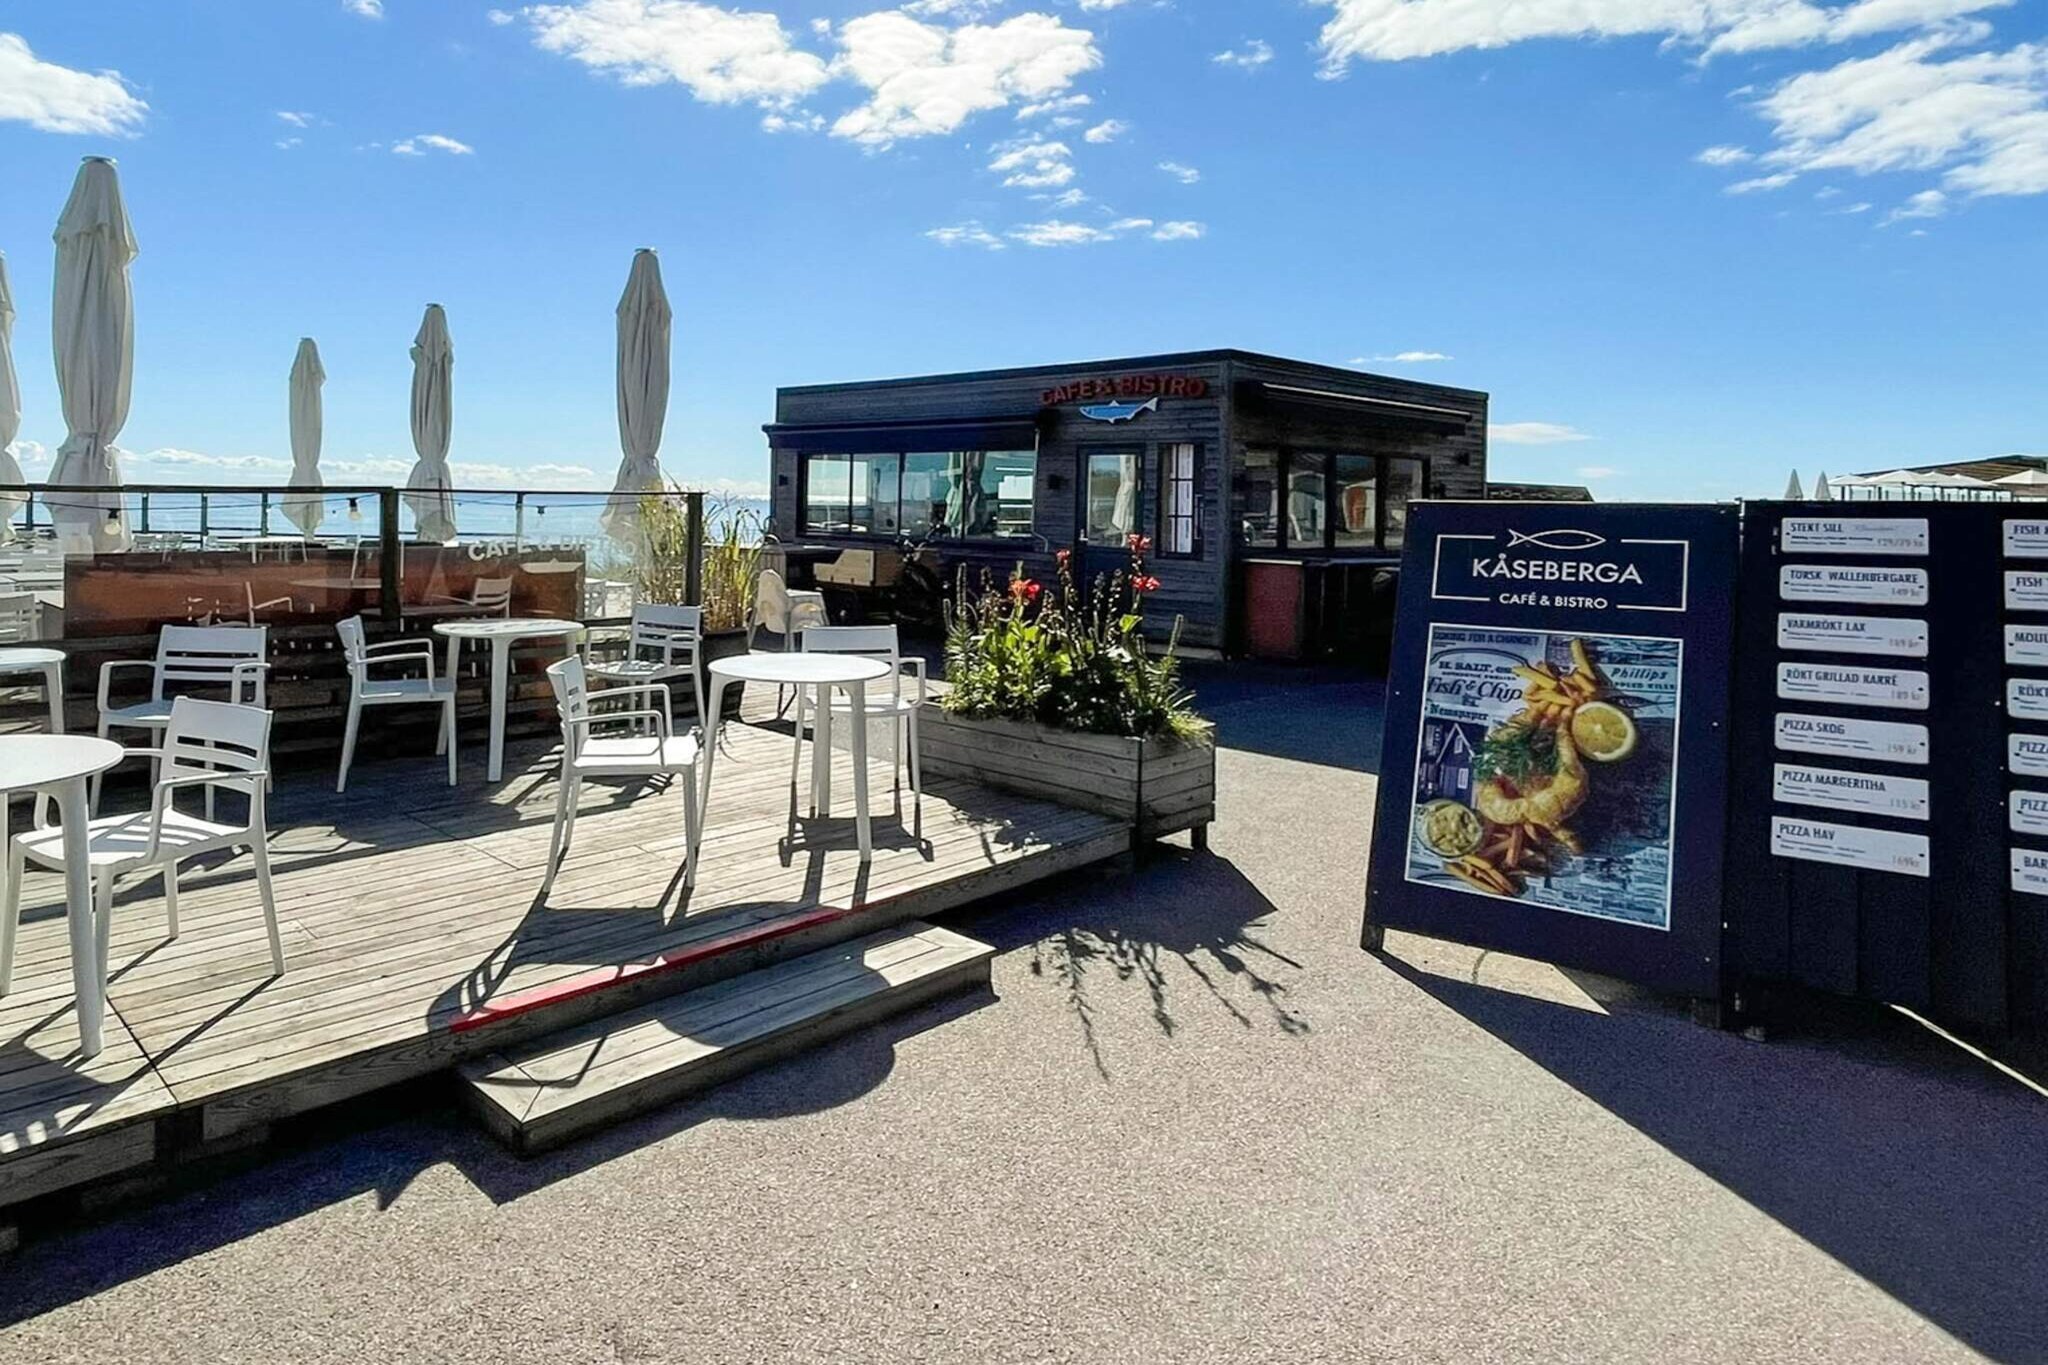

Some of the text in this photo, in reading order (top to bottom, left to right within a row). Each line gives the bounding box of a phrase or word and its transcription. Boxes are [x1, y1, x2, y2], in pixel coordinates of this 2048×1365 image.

[1095, 377, 1113, 395] &
[1119, 373, 1205, 397] BISTRO
[1790, 522, 1819, 532] STEKT
[1822, 523, 1844, 533] SILL
[2013, 525, 2040, 535] FISH
[538, 536, 553, 551] &
[1472, 553, 1643, 585] KÅSEBERGA
[1790, 570, 1919, 584] TORSK WALLENBERGARE
[2016, 577, 2042, 587] FISH
[1499, 592, 1608, 610] CAFÉ & BISTRO
[1787, 619, 1867, 632] VARMRÖKT LAX
[1610, 667, 1668, 681] Phillips
[1786, 668, 1898, 686] RÖKT GRILLAD KARRÉ
[1427, 676, 1466, 695] Fish
[1466, 680, 1477, 691] &
[1783, 719, 1845, 735] PIZZA SKOG
[1782, 770, 1813, 783] PIZZA
[1815, 774, 1887, 792] MARGERITHA
[1779, 824, 1835, 841] PIZZA HAV
